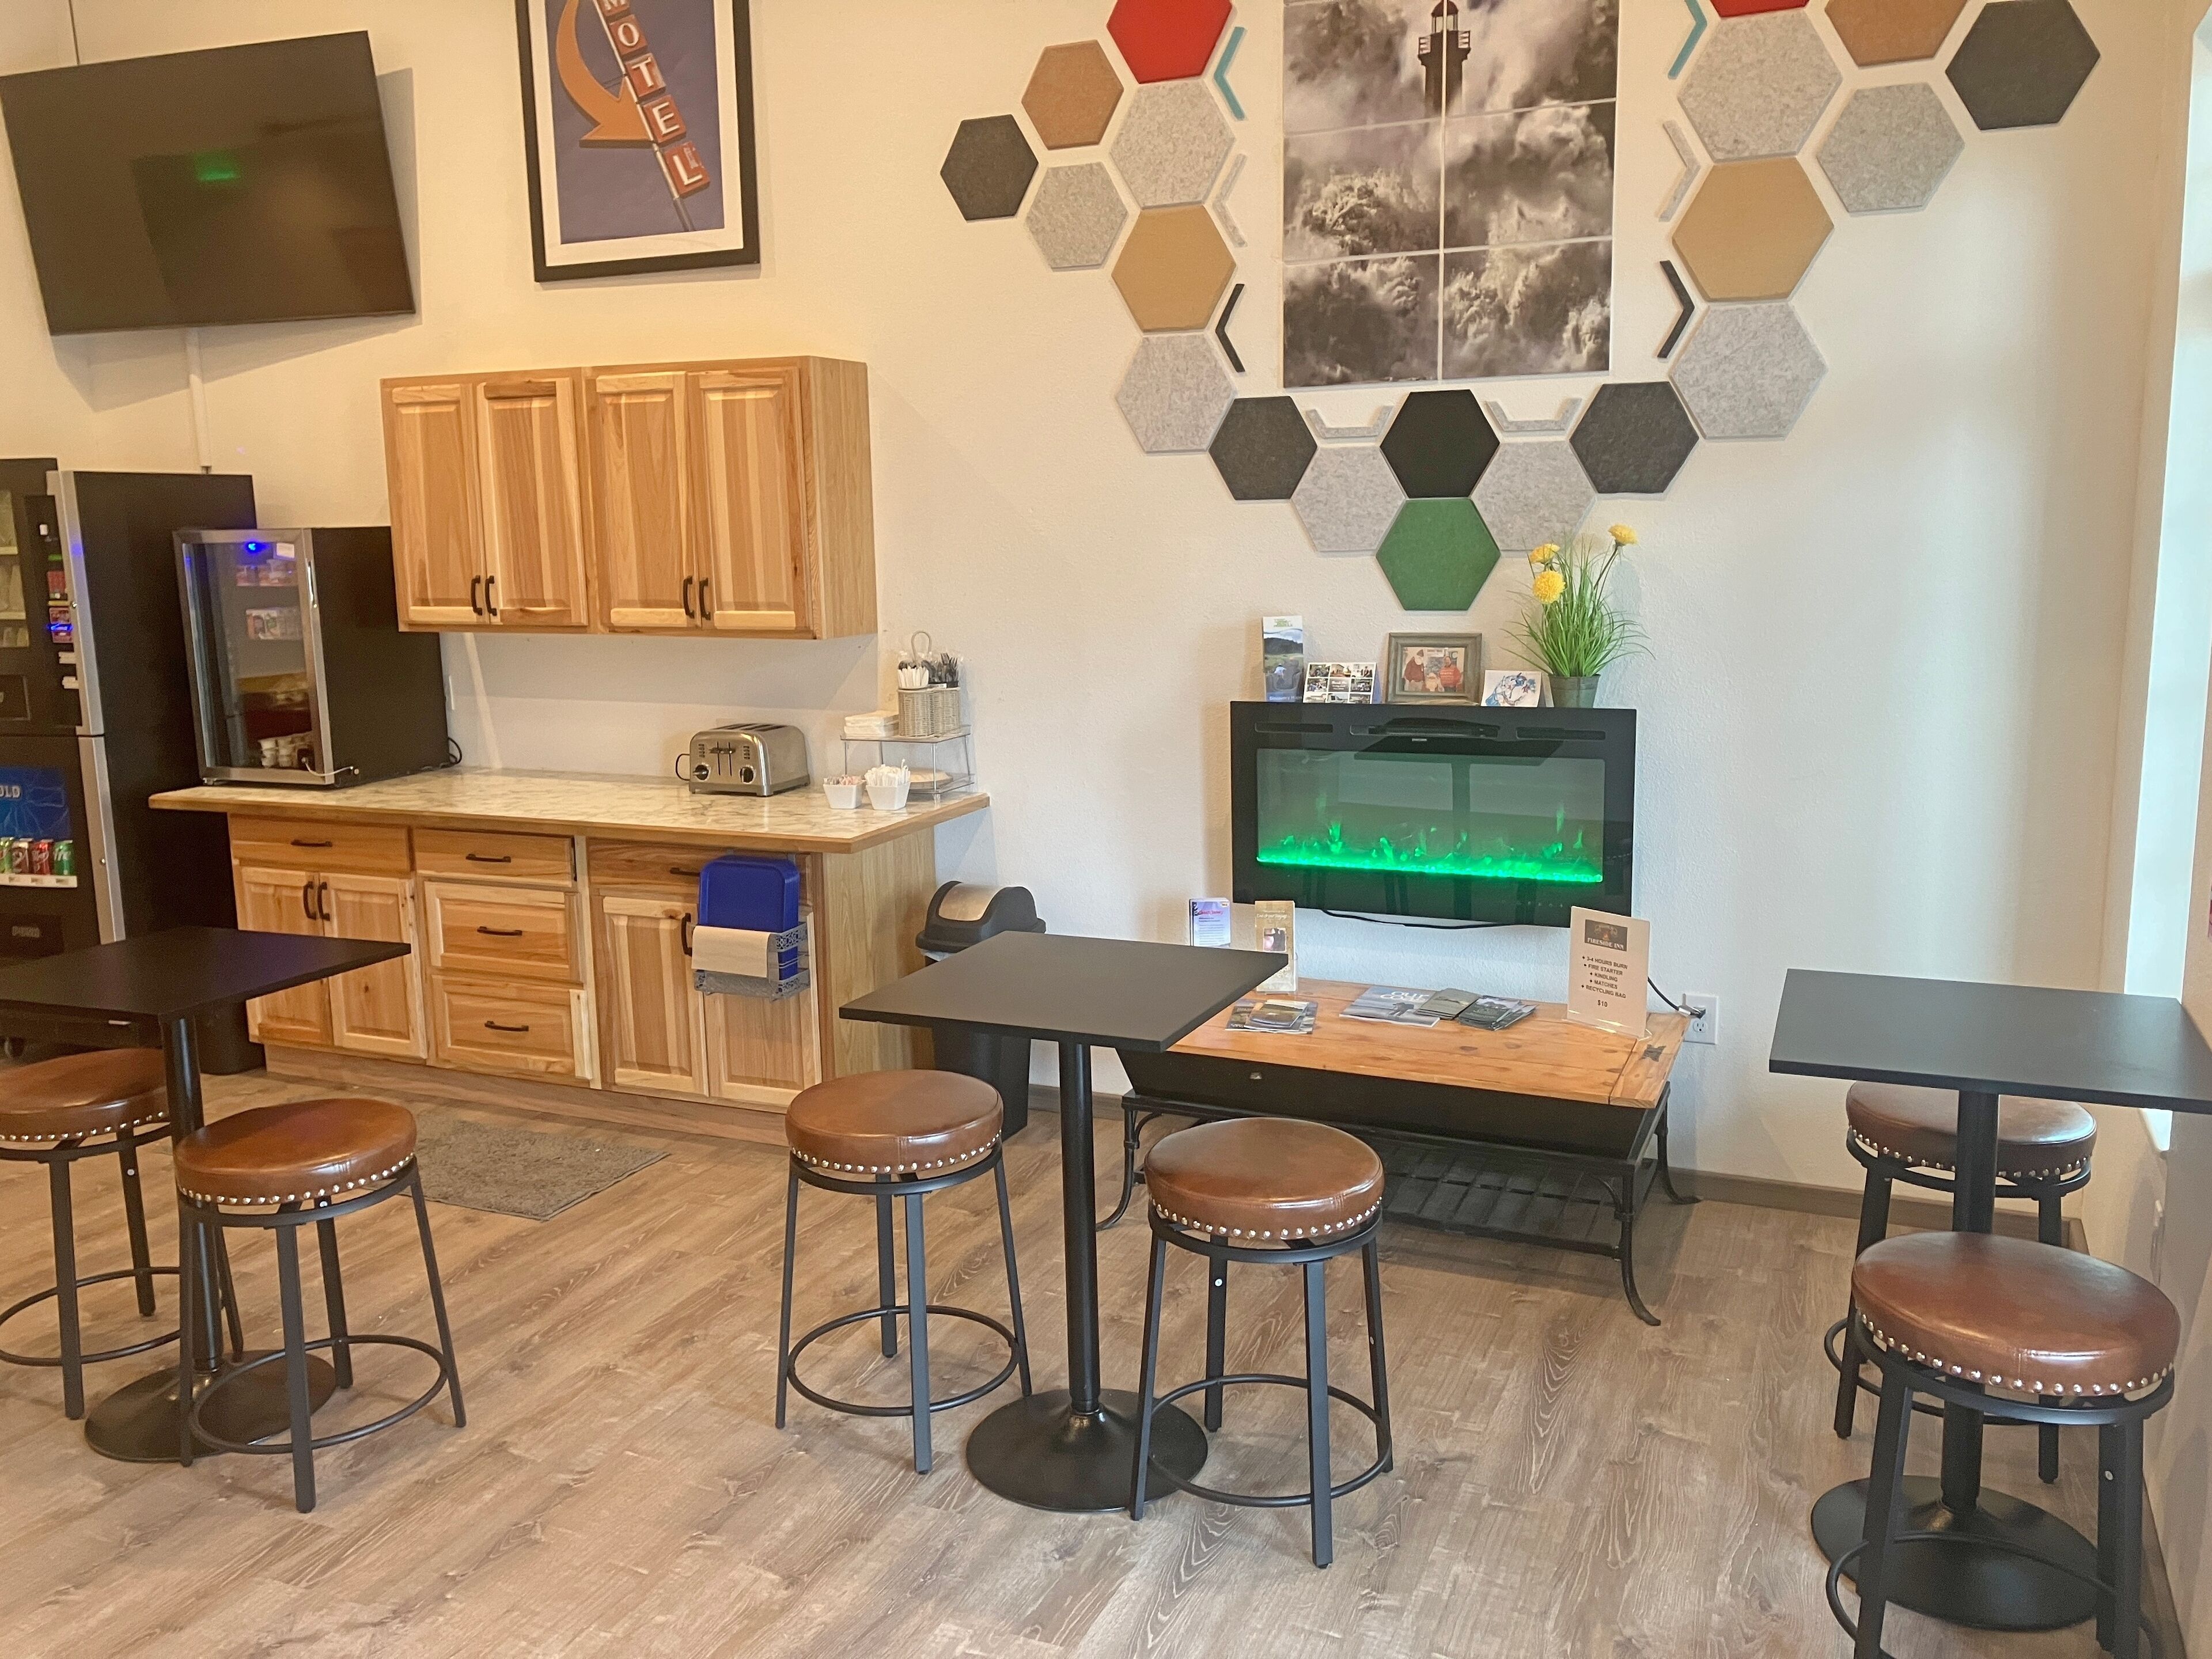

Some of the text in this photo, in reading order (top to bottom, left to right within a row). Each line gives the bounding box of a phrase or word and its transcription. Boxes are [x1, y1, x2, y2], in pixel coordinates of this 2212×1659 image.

[1587, 937, 1613, 948] FIRESIDE
[1601, 965, 1623, 975] STARTER
[1594, 972, 1618, 982] KINDLING
[1594, 980, 1618, 989] MATCHES
[1586, 984, 1613, 996] RECYCLING
